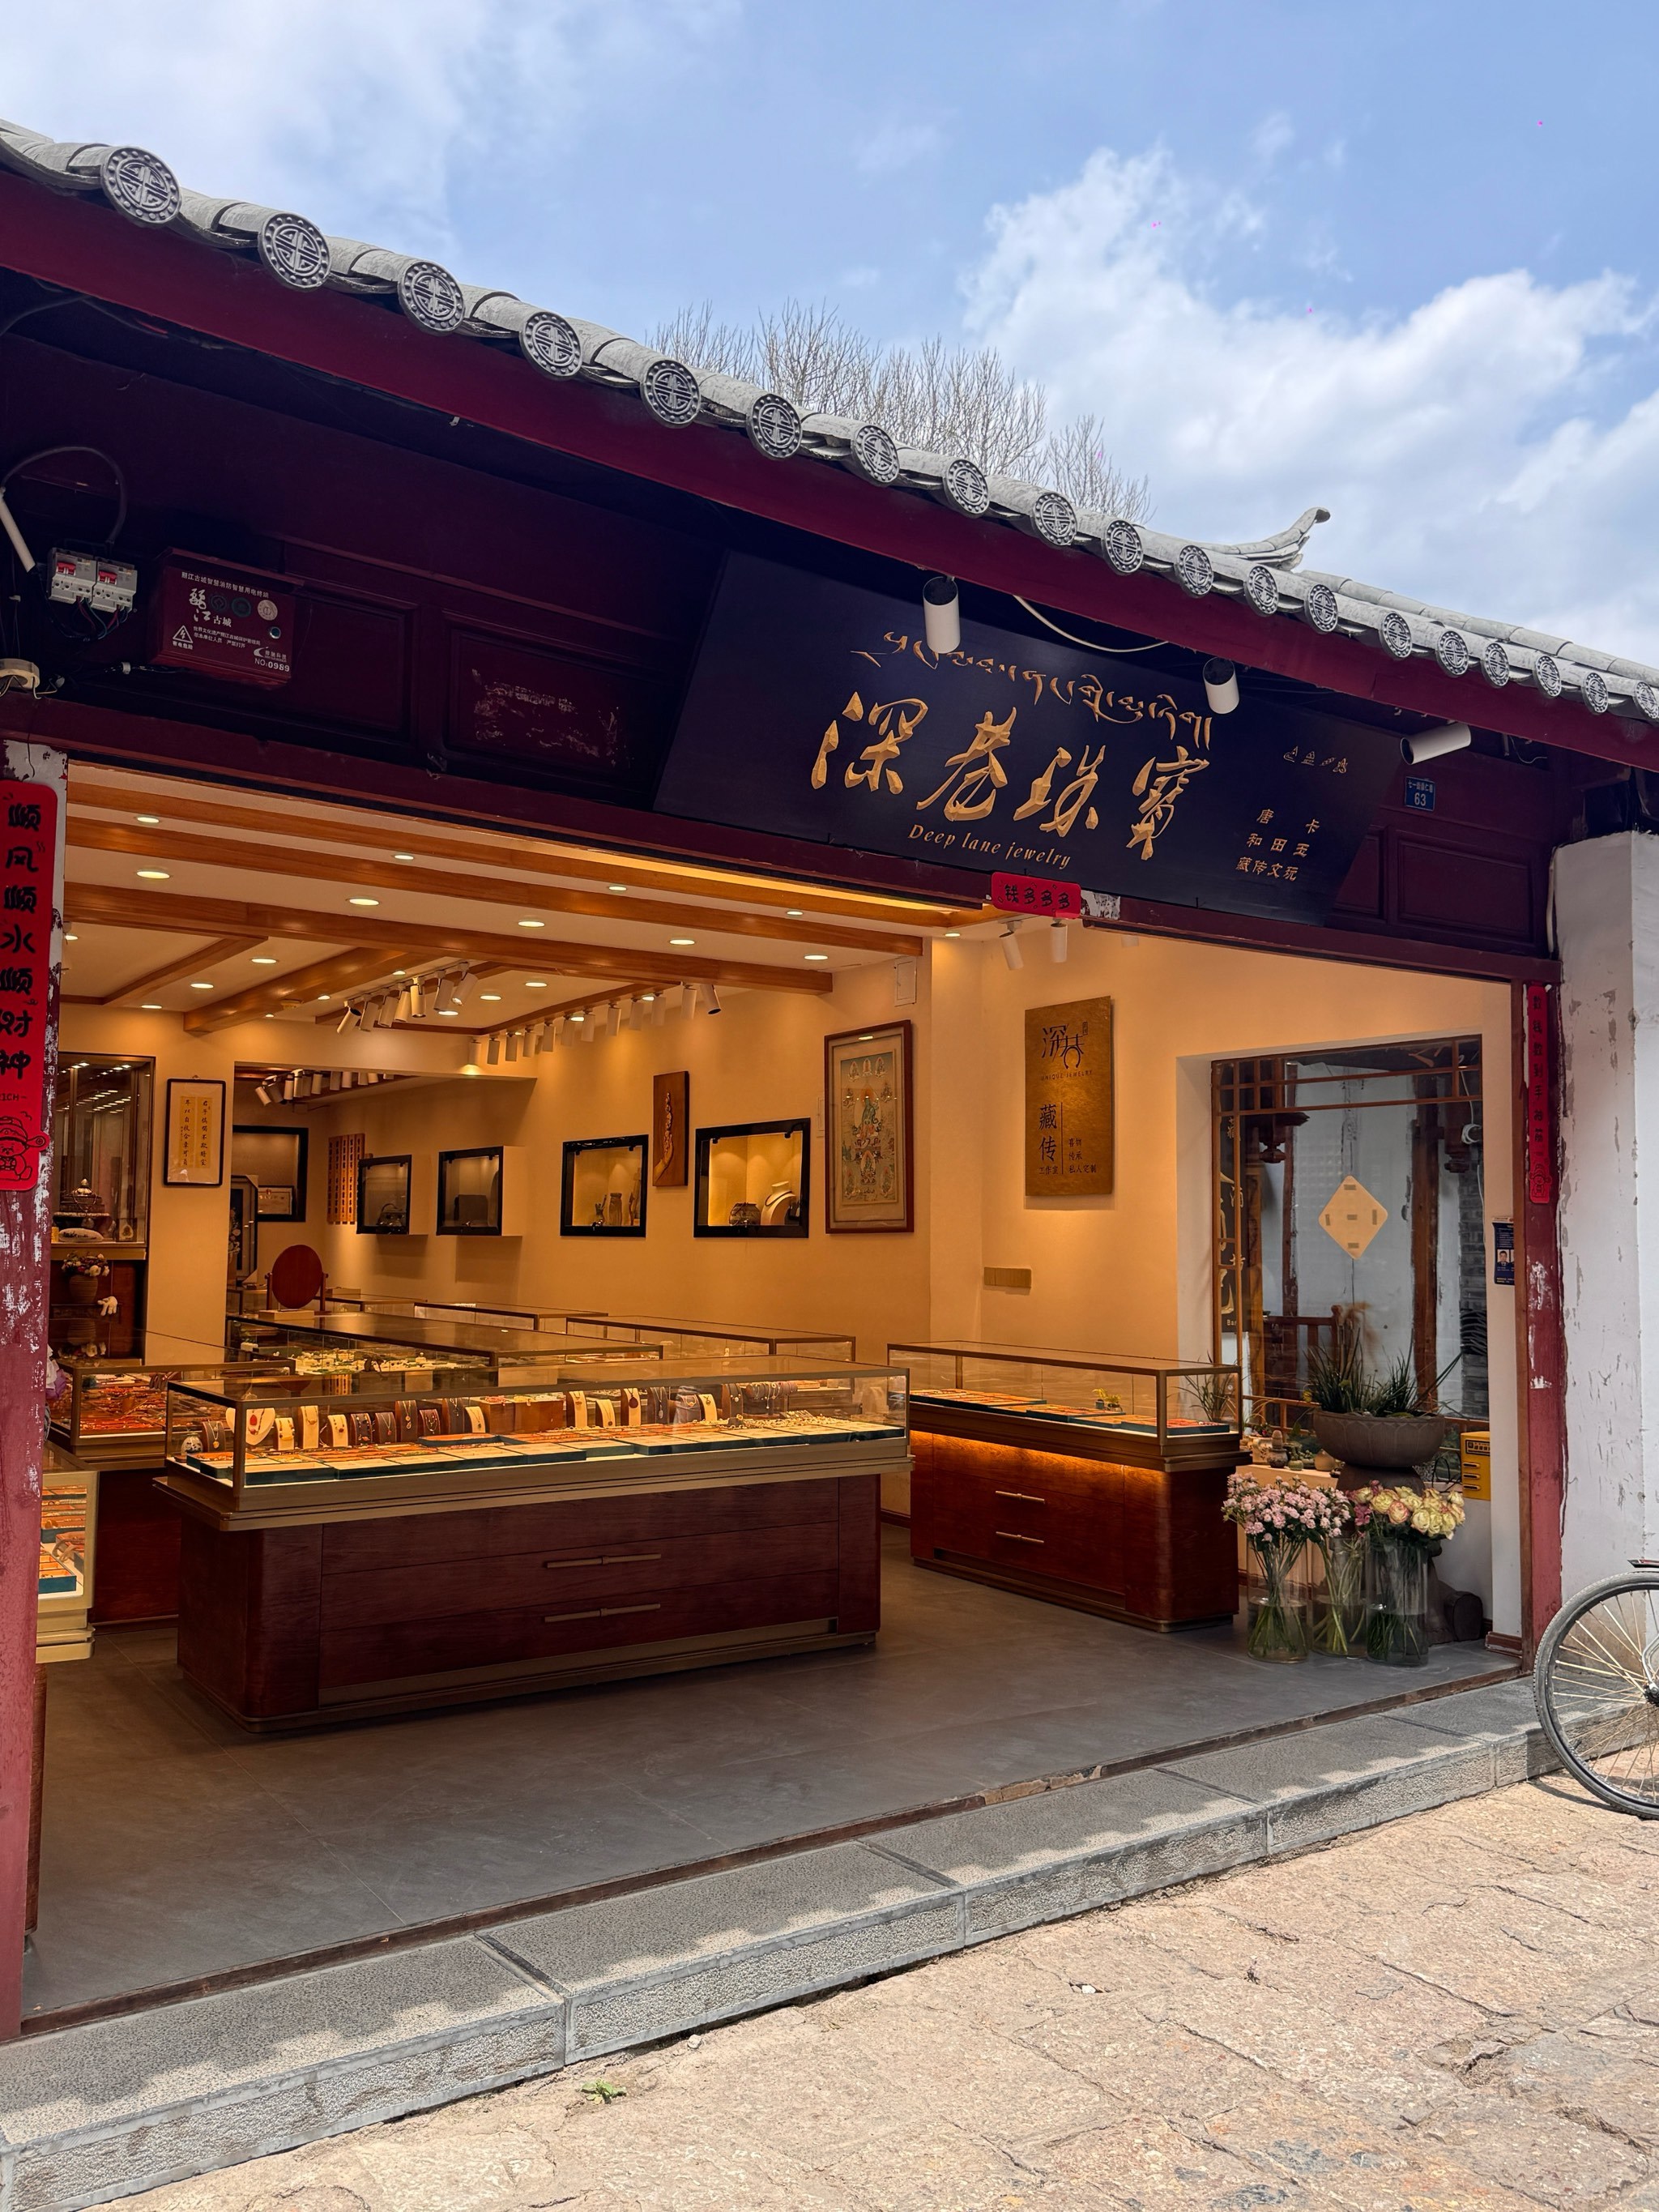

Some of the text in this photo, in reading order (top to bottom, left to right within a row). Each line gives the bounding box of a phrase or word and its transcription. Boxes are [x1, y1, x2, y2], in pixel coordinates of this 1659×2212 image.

[1414, 792, 1426, 806] 63
[907, 824, 1071, 870] Deep lane jewelry
[1246, 833, 1310, 858] 和田玉
[1004, 884, 1071, 910] 钱多多多
[1041, 1070, 1093, 1081] UNIQUE JEWELRY
[1038, 1104, 1058, 1162] 藏传
[1038, 1165, 1059, 1175] 工作室
